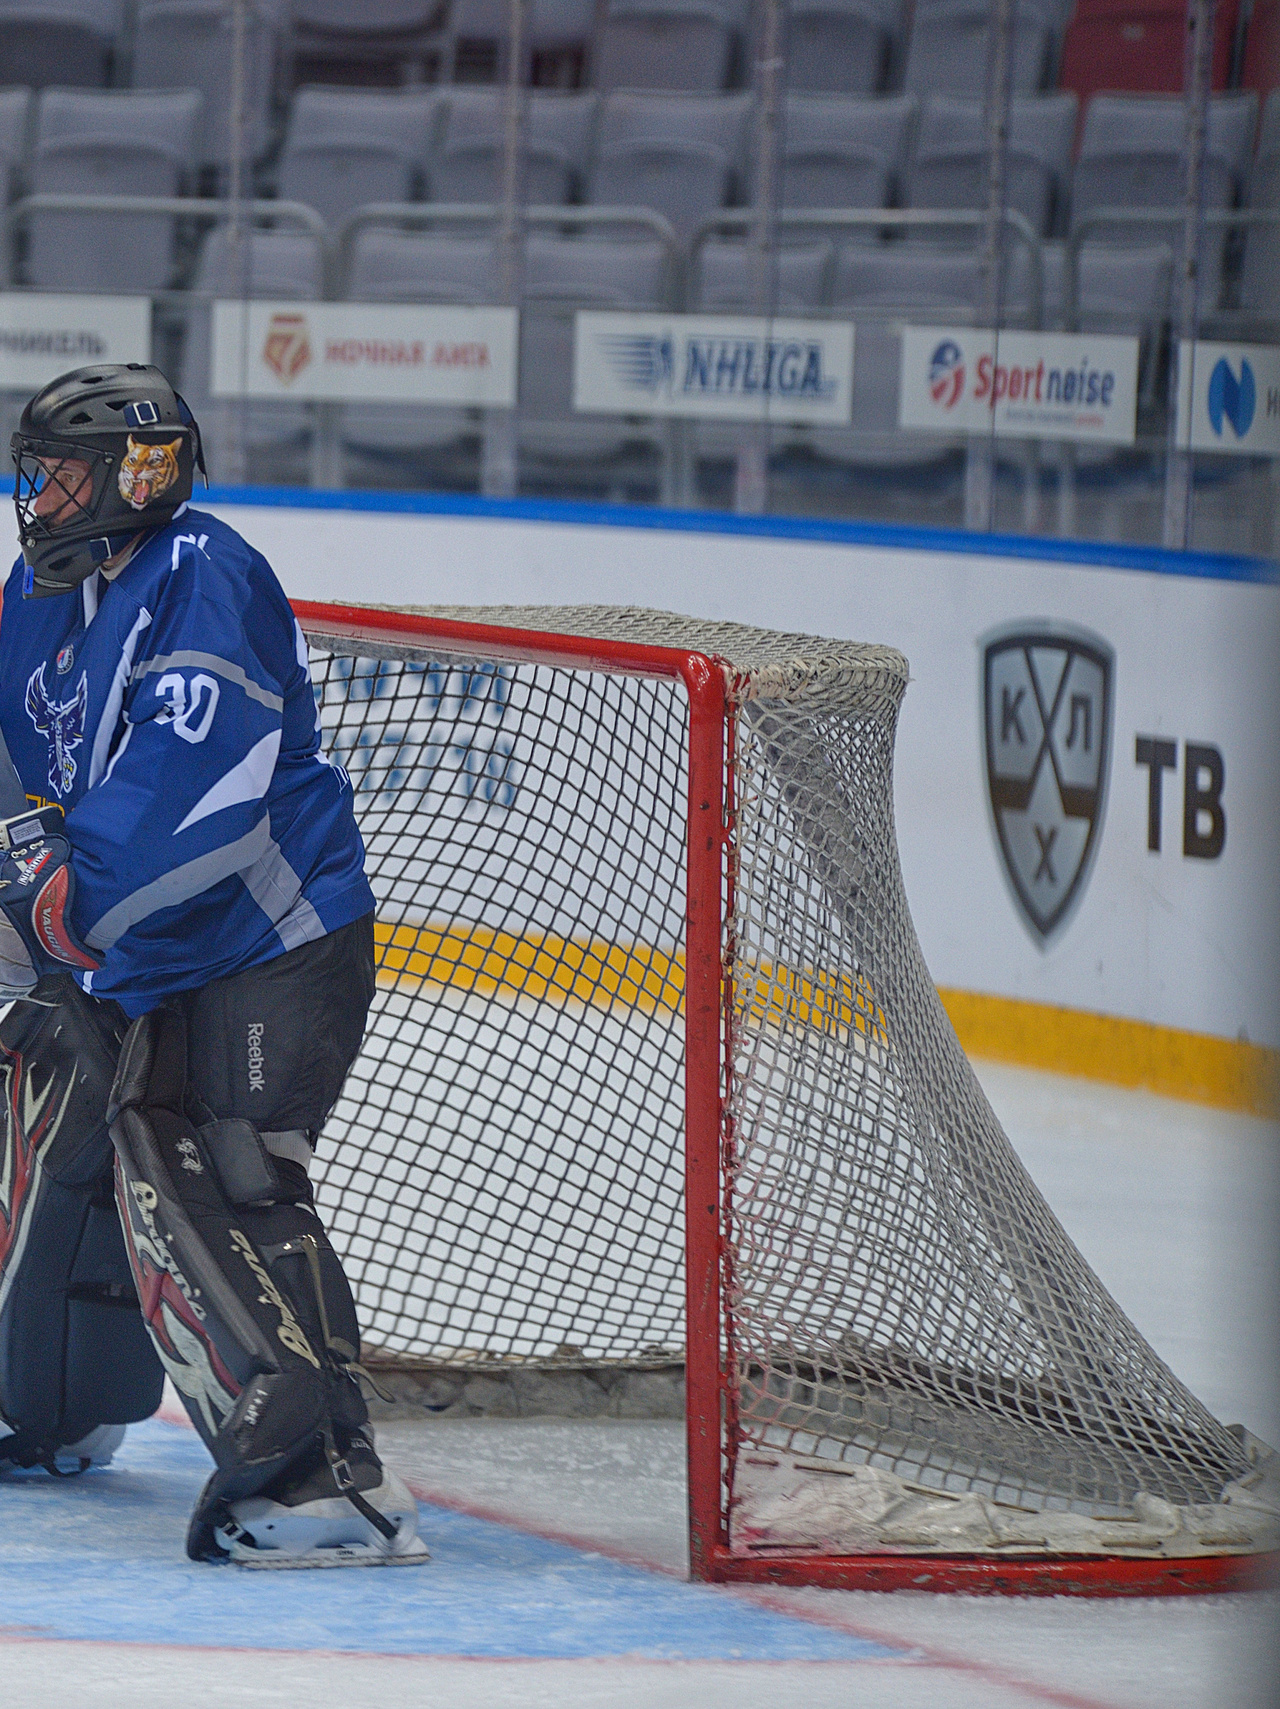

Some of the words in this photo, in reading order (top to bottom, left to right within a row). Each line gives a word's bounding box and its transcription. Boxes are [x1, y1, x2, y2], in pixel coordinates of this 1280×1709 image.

[685, 338, 822, 393] NHLIGA
[153, 673, 220, 744] 30
[1134, 733, 1227, 862] ТВ
[248, 1023, 265, 1092] Reebok
